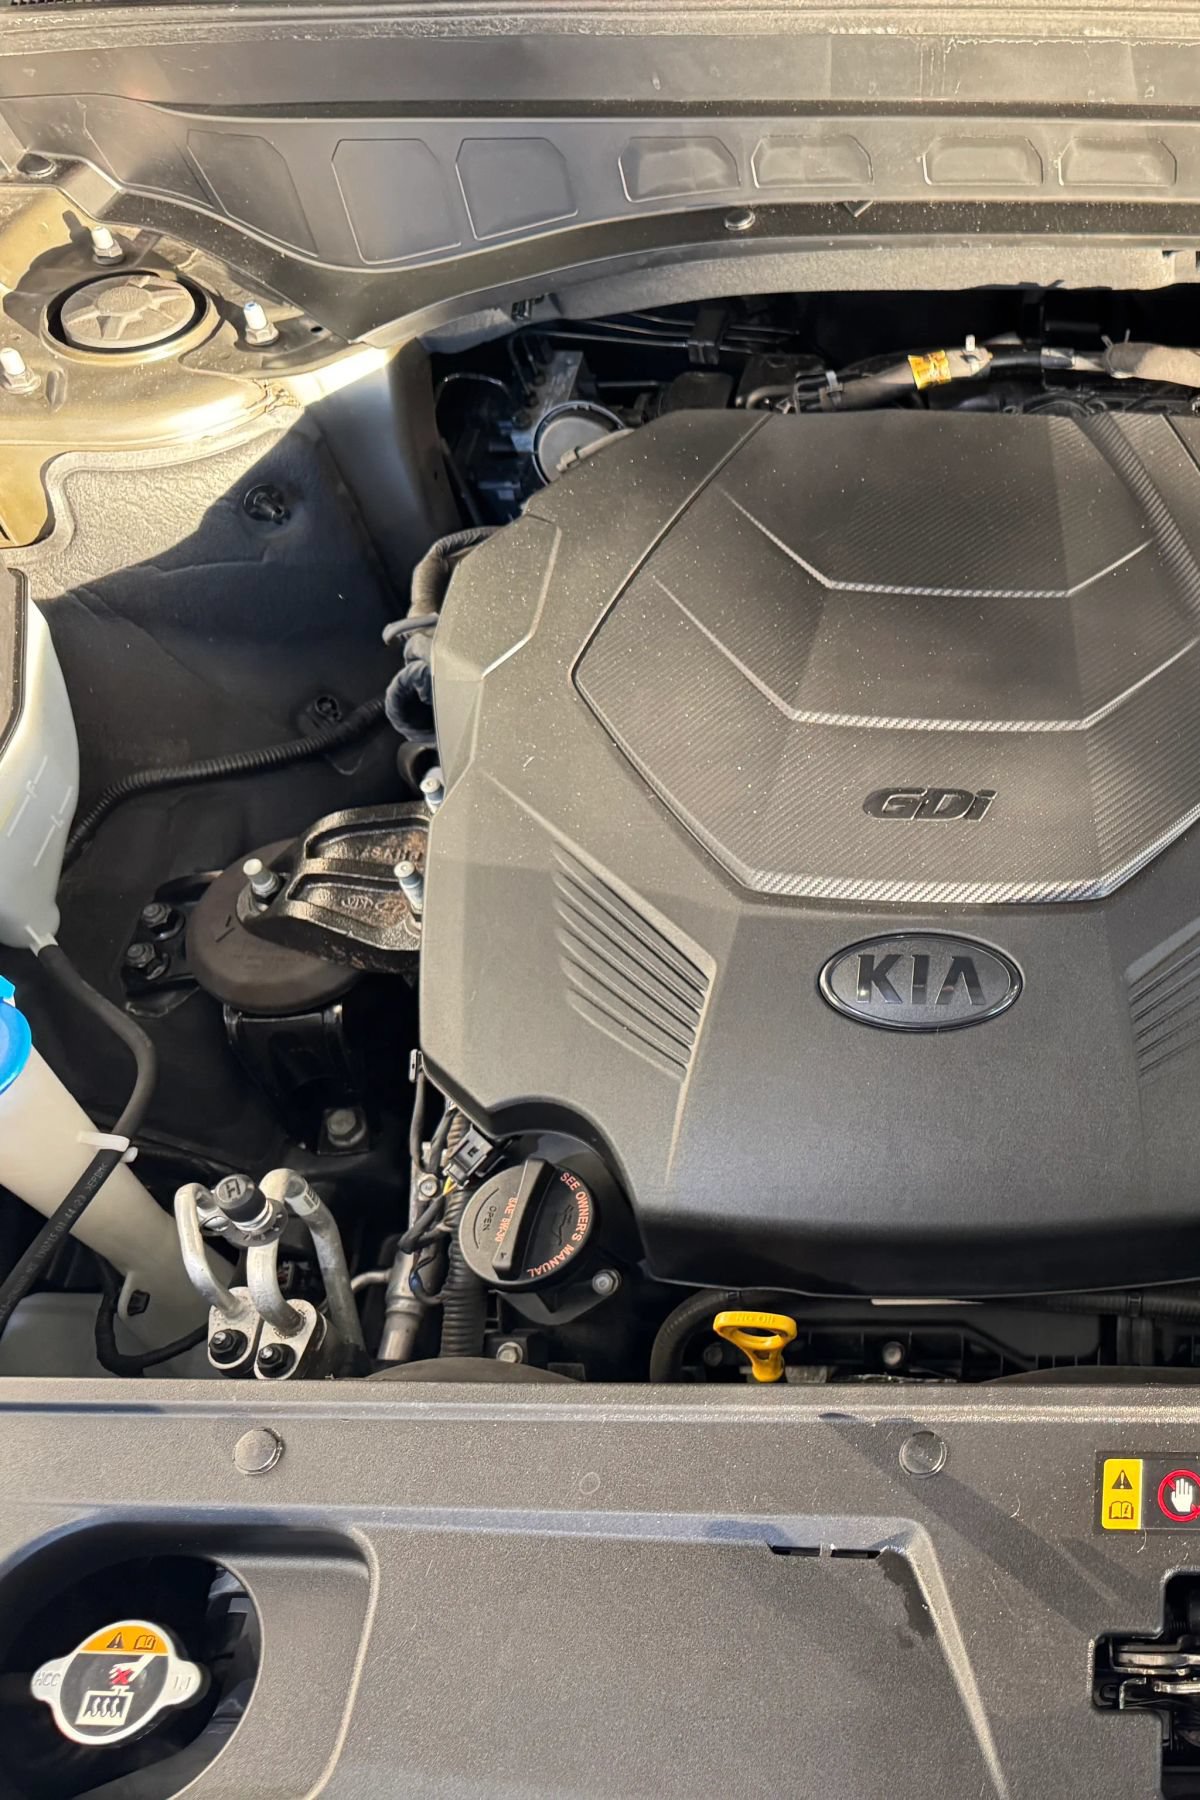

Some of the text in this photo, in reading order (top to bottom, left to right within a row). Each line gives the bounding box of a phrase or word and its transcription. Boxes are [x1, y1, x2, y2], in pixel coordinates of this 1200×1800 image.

[862, 786, 998, 823] GDi
[856, 953, 987, 1006] KIA
[482, 1205, 497, 1232] OPEN
[527, 1172, 590, 1278] SEE OWNER'S MANUAL
